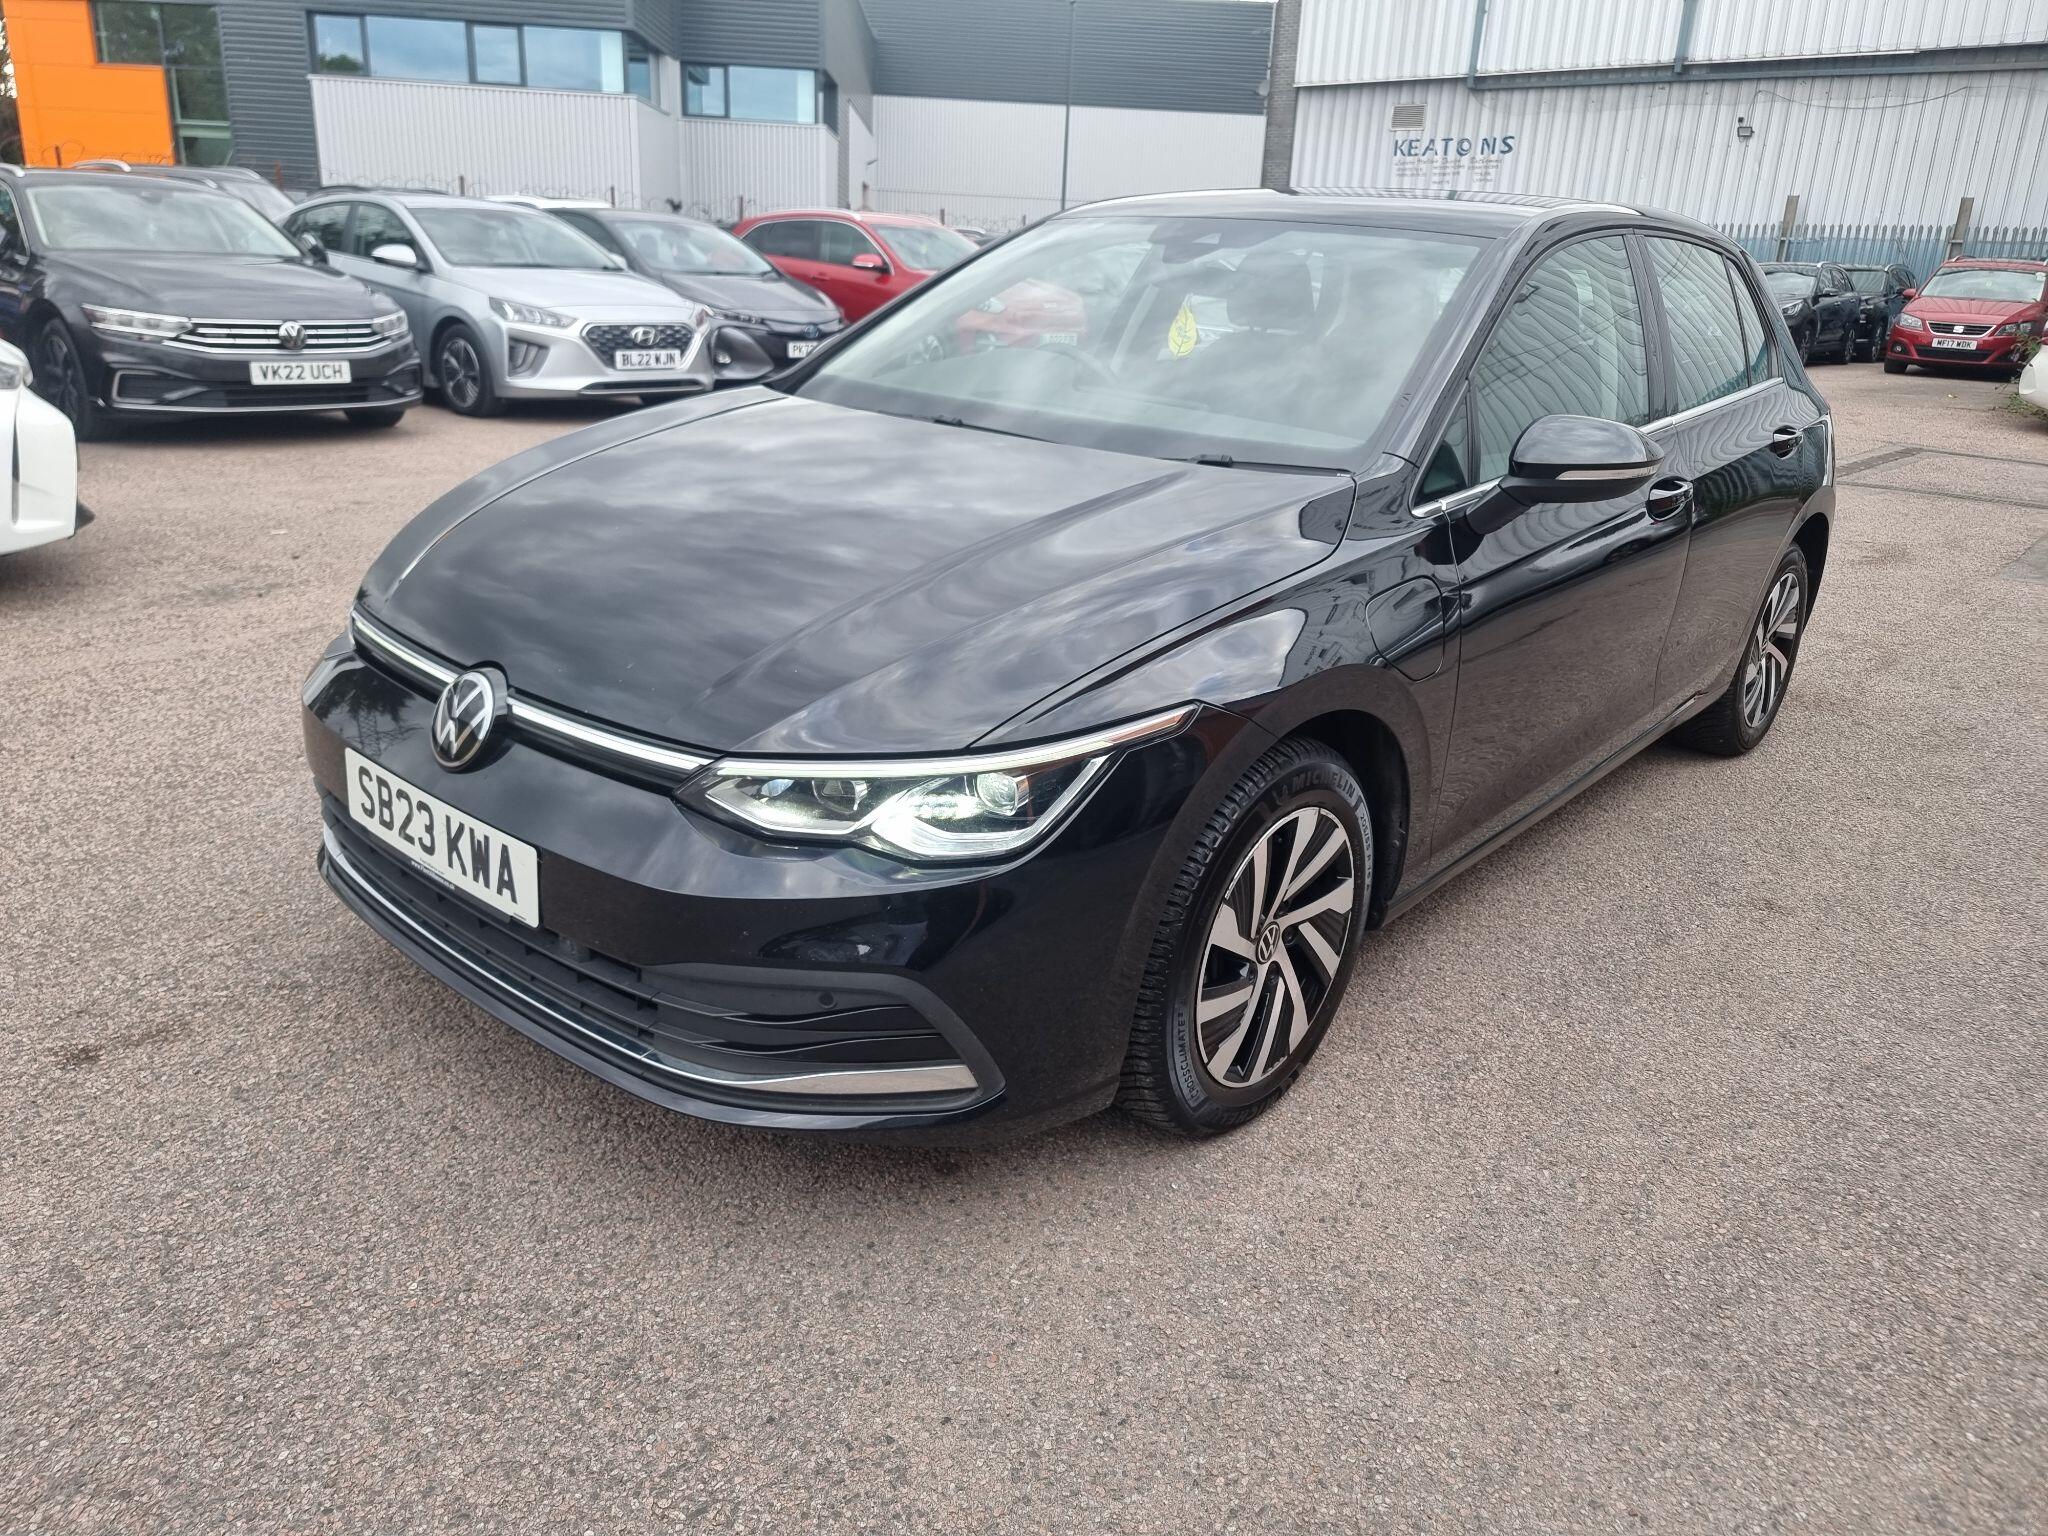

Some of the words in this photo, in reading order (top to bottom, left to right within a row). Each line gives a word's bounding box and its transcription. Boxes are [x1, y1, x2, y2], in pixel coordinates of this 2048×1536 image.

[1394, 135, 1516, 157] KEATONS
[622, 353, 652, 367] BL22
[260, 365, 306, 380] VK22
[311, 364, 343, 379] UCH
[358, 765, 436, 857] SB23
[445, 814, 518, 904] KWA
